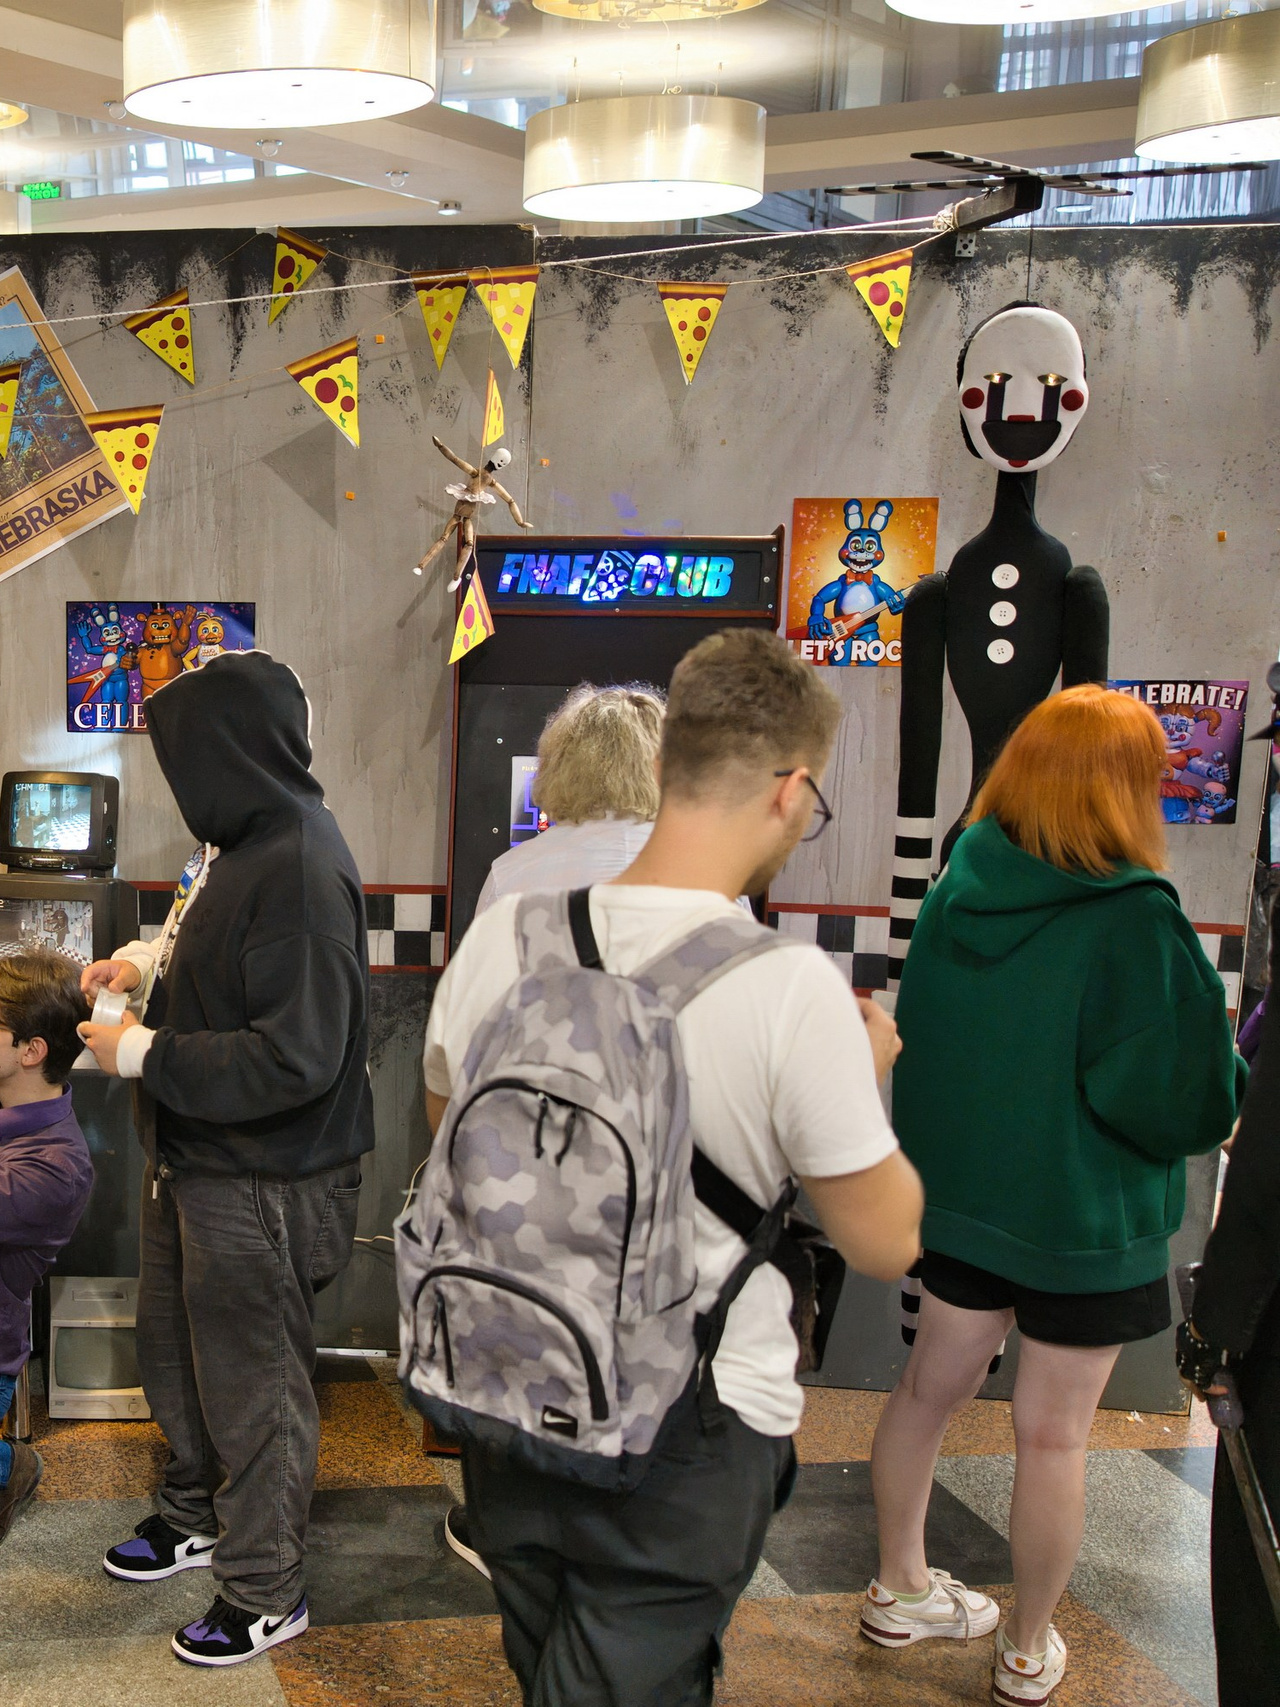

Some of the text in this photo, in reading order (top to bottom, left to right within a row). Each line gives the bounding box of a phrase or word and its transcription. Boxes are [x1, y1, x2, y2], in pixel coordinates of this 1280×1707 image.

[497, 553, 734, 597] FNAF CLUB
[38, 783, 49, 792] 01
